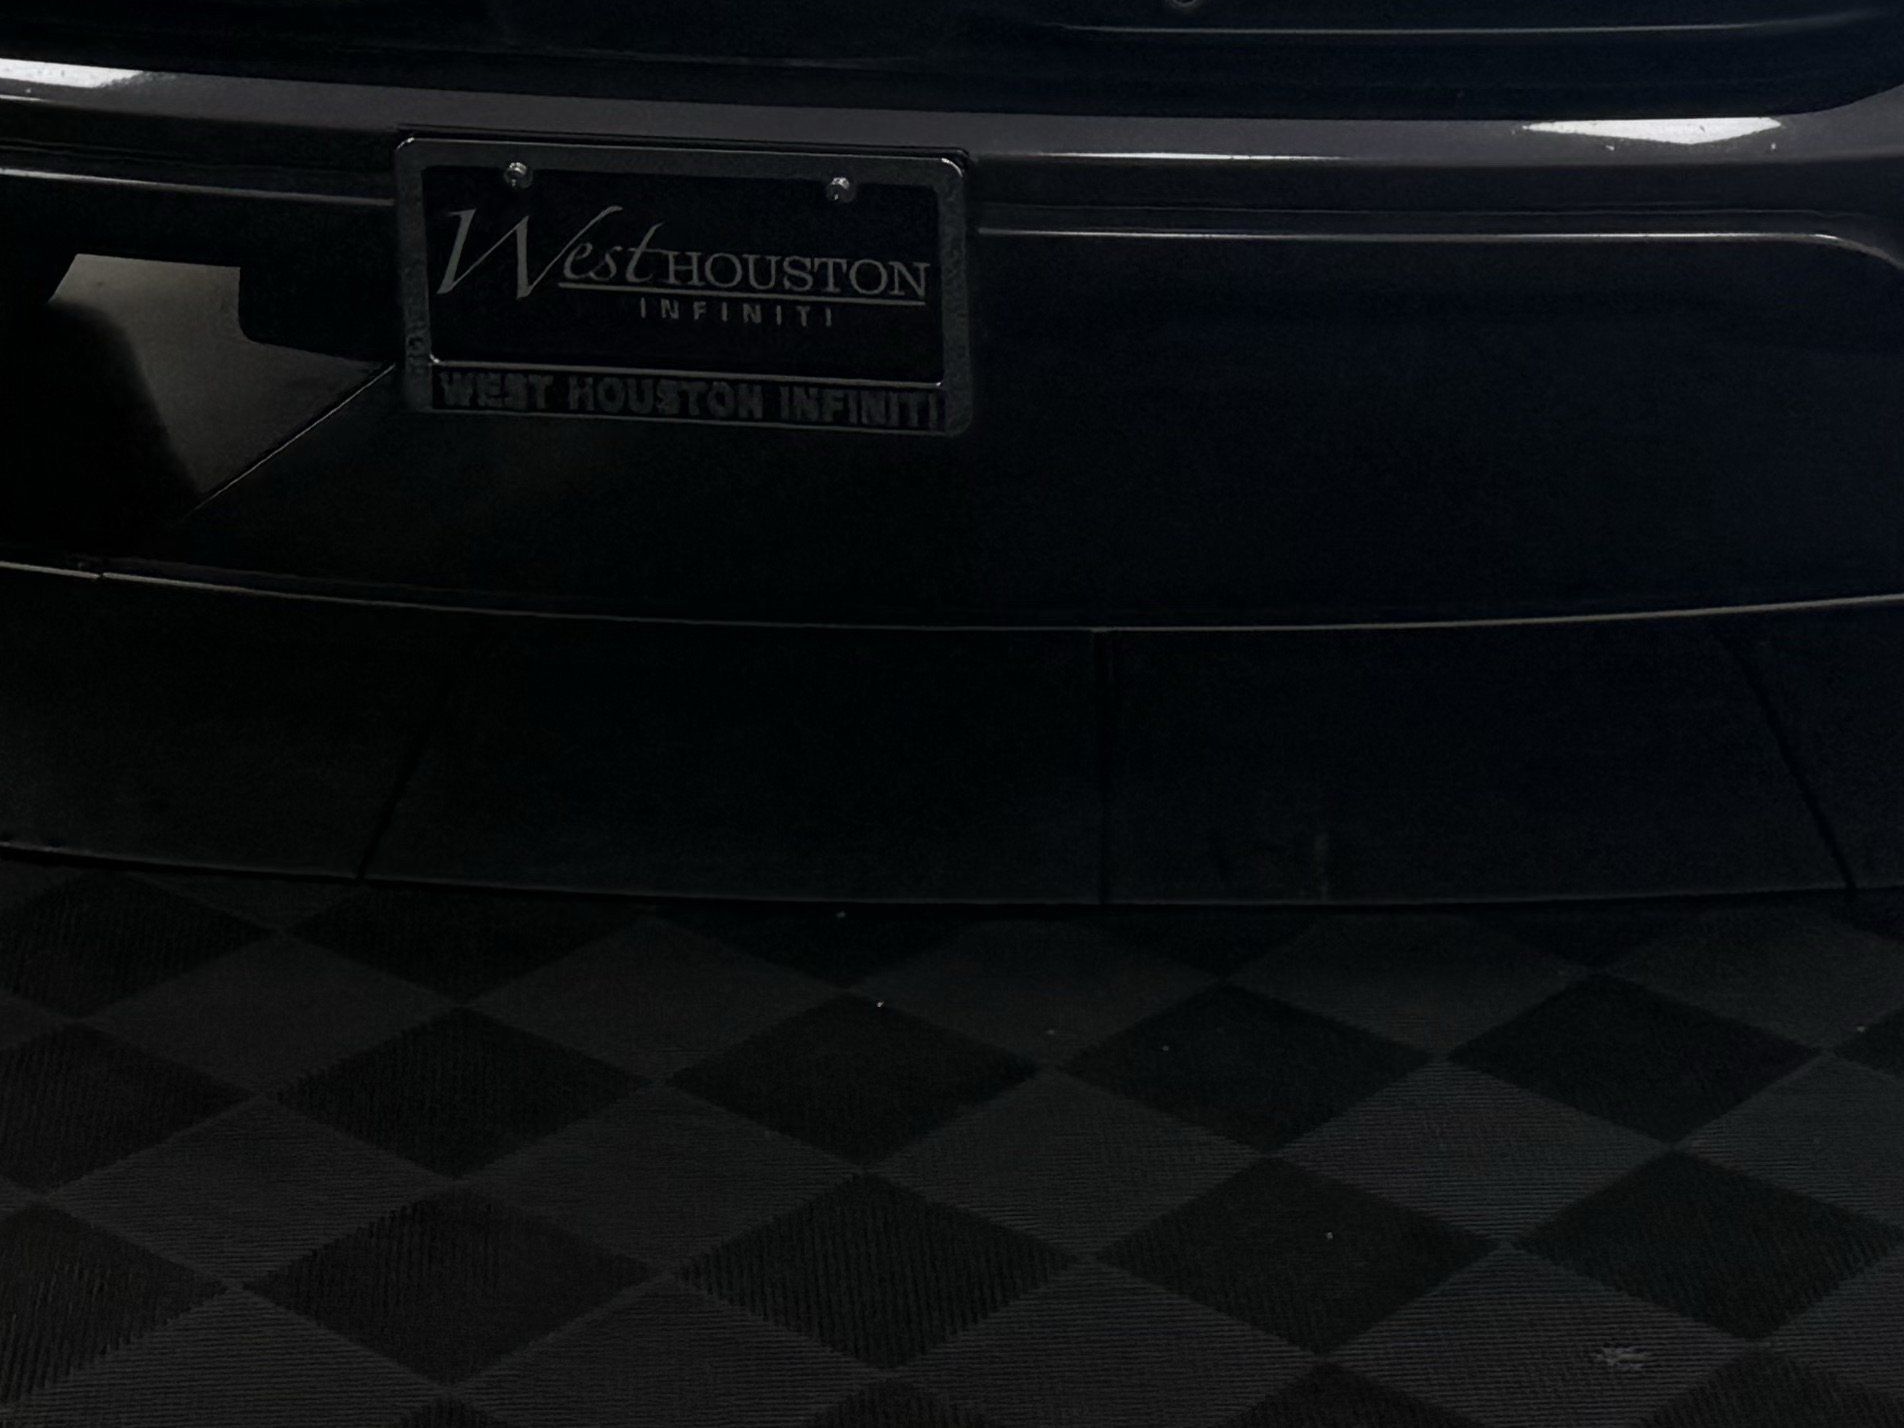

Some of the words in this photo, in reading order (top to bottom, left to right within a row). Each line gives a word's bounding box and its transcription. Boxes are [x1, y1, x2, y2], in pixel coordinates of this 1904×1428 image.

[640, 297, 833, 328] INFINITI
[439, 372, 554, 411] WEST
[566, 377, 764, 420] HOUSTON
[779, 387, 940, 429] INFINITI
